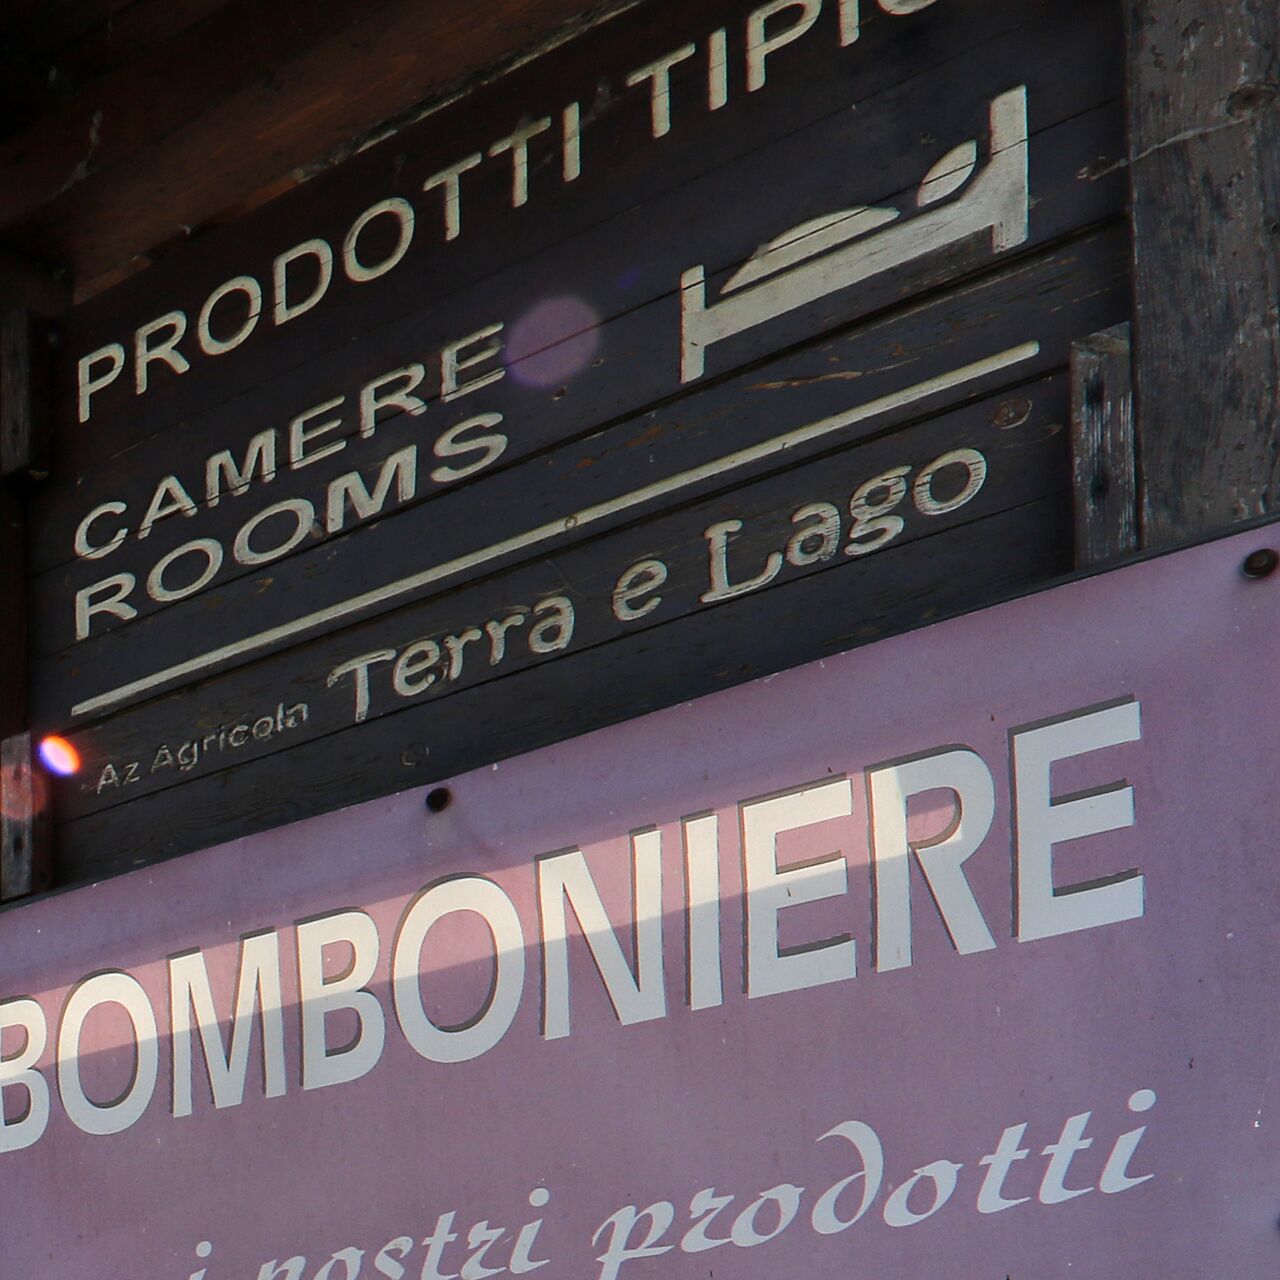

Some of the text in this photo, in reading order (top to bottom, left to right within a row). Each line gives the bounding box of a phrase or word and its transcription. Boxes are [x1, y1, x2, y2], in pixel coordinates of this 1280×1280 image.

[77, 0, 938, 424] PRODOTTI TIPI
[74, 321, 505, 560] CAMERE
[74, 411, 510, 641] ROOMS
[95, 447, 987, 795] Az Agricola Terra e Lago
